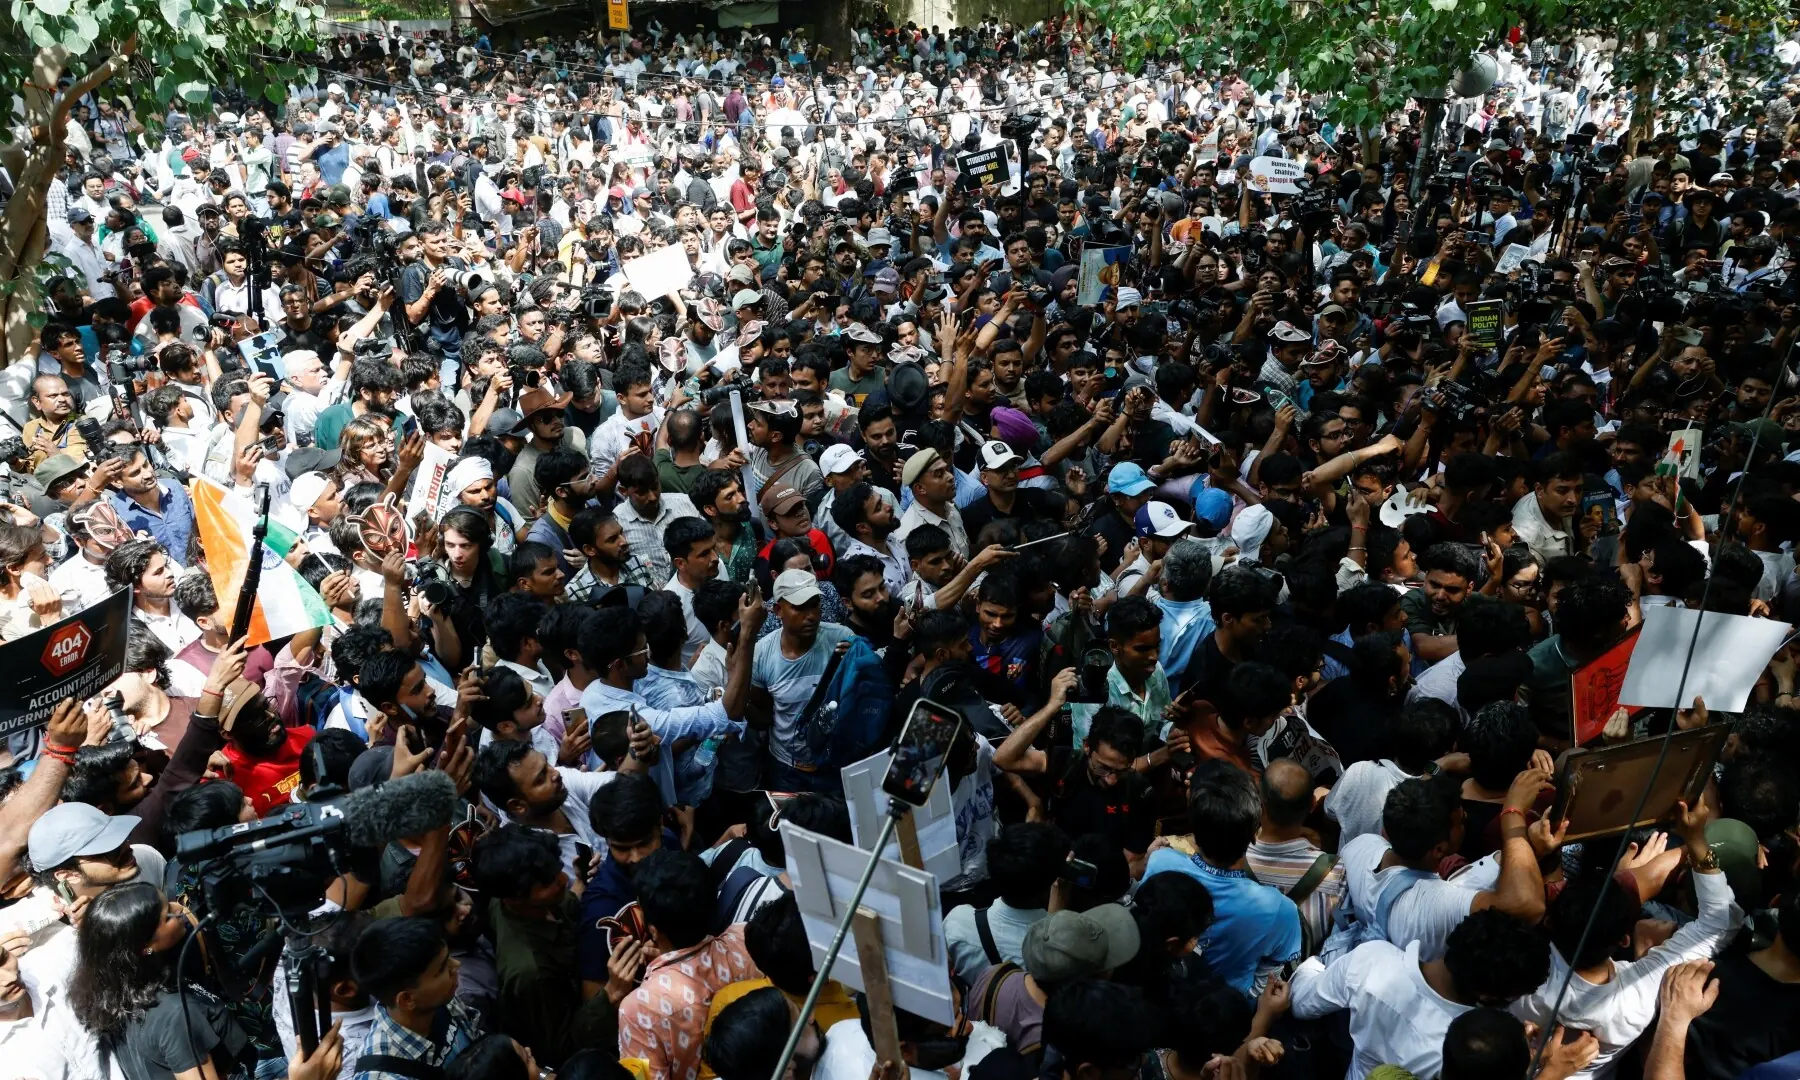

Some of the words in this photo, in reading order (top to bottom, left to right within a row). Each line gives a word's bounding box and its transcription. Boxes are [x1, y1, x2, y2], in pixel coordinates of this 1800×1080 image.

[966, 152, 990, 166] STUDENTS
[990, 151, 998, 159] KA
[969, 164, 987, 176] FUTURE
[1472, 314, 1498, 323] INDIAN
[1472, 321, 1498, 329] POLITY
[51, 632, 82, 658] 404
[59, 651, 79, 667] ERROR
[28, 664, 102, 711] ACCOUNTABLE
[76, 684, 94, 702] NOT
[94, 662, 121, 690] FOUND
